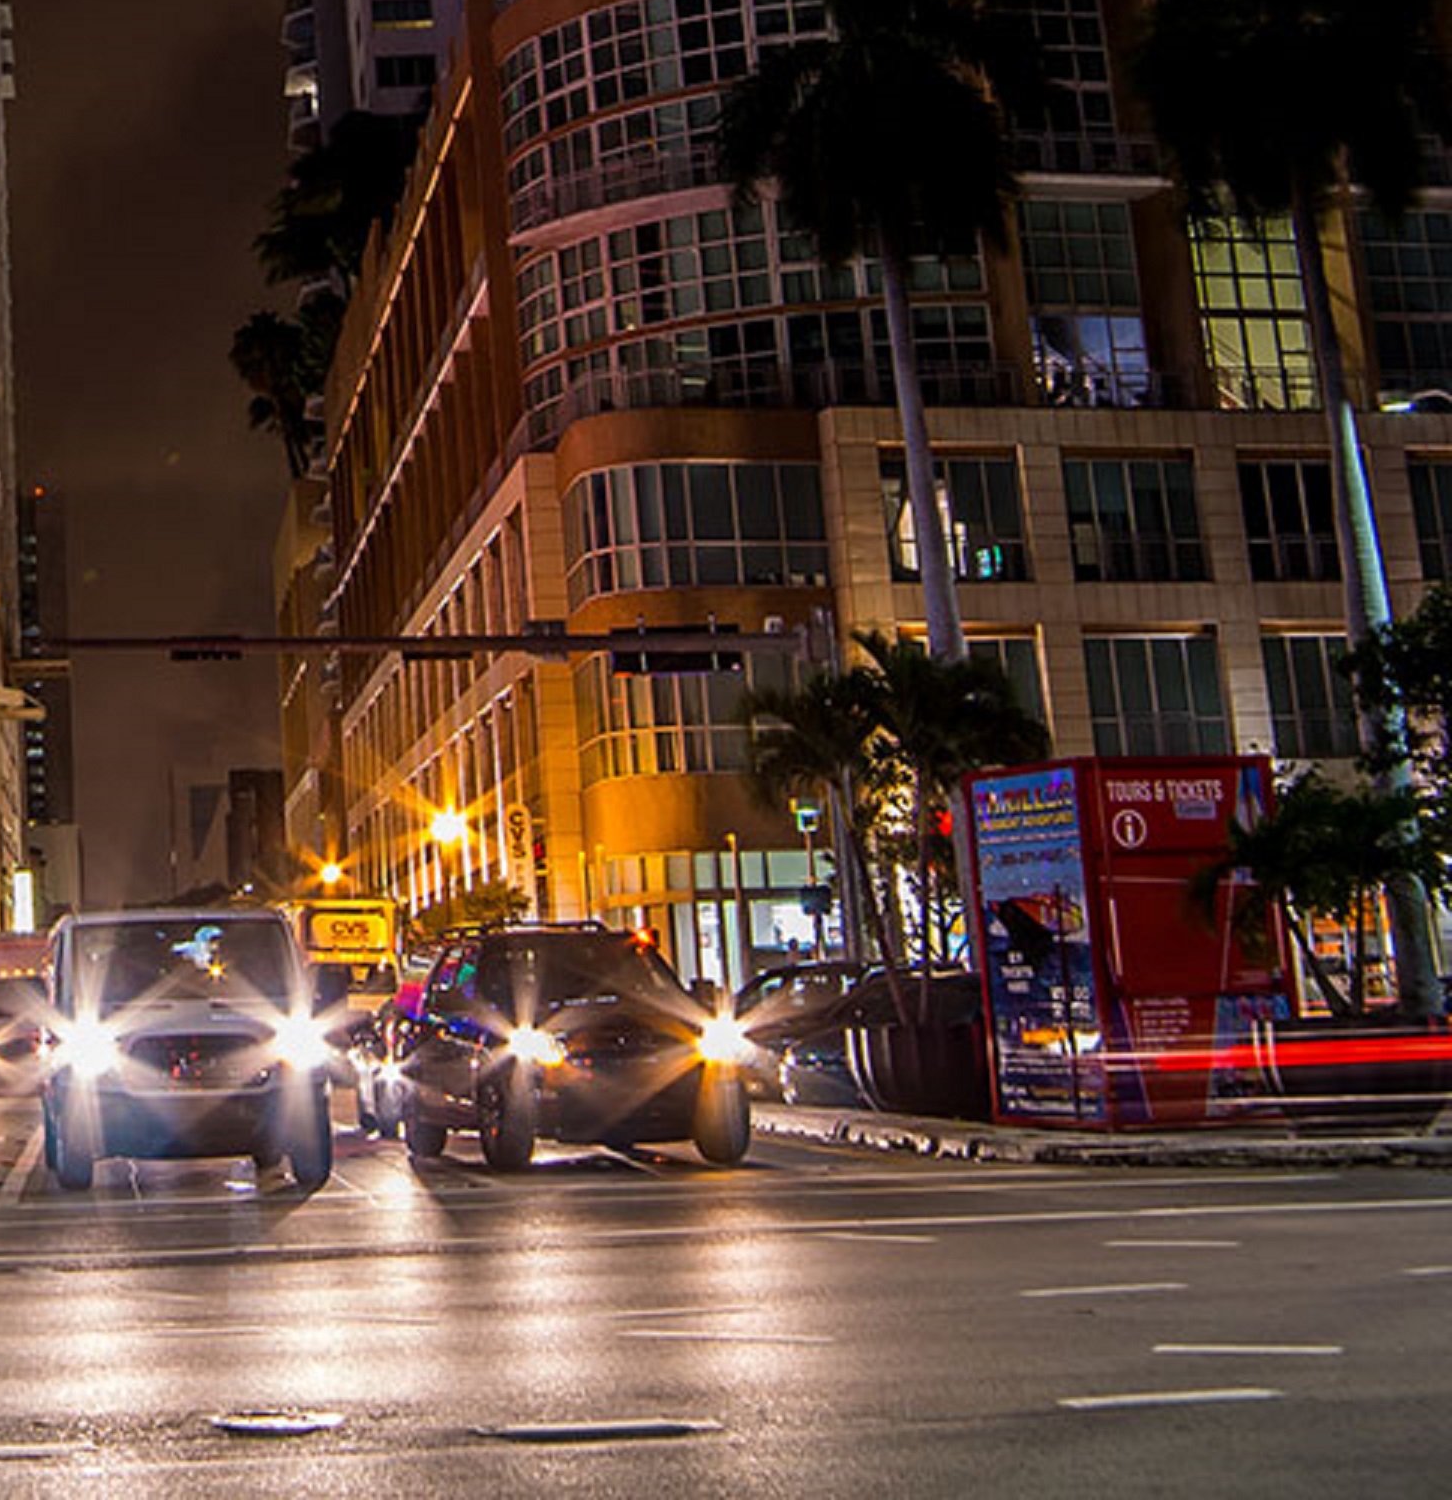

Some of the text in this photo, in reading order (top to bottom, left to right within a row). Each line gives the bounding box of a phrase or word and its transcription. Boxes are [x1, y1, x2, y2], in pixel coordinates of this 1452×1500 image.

[1106, 780, 1224, 802] TOURS & TICKETS
[509, 810, 526, 859] CVS
